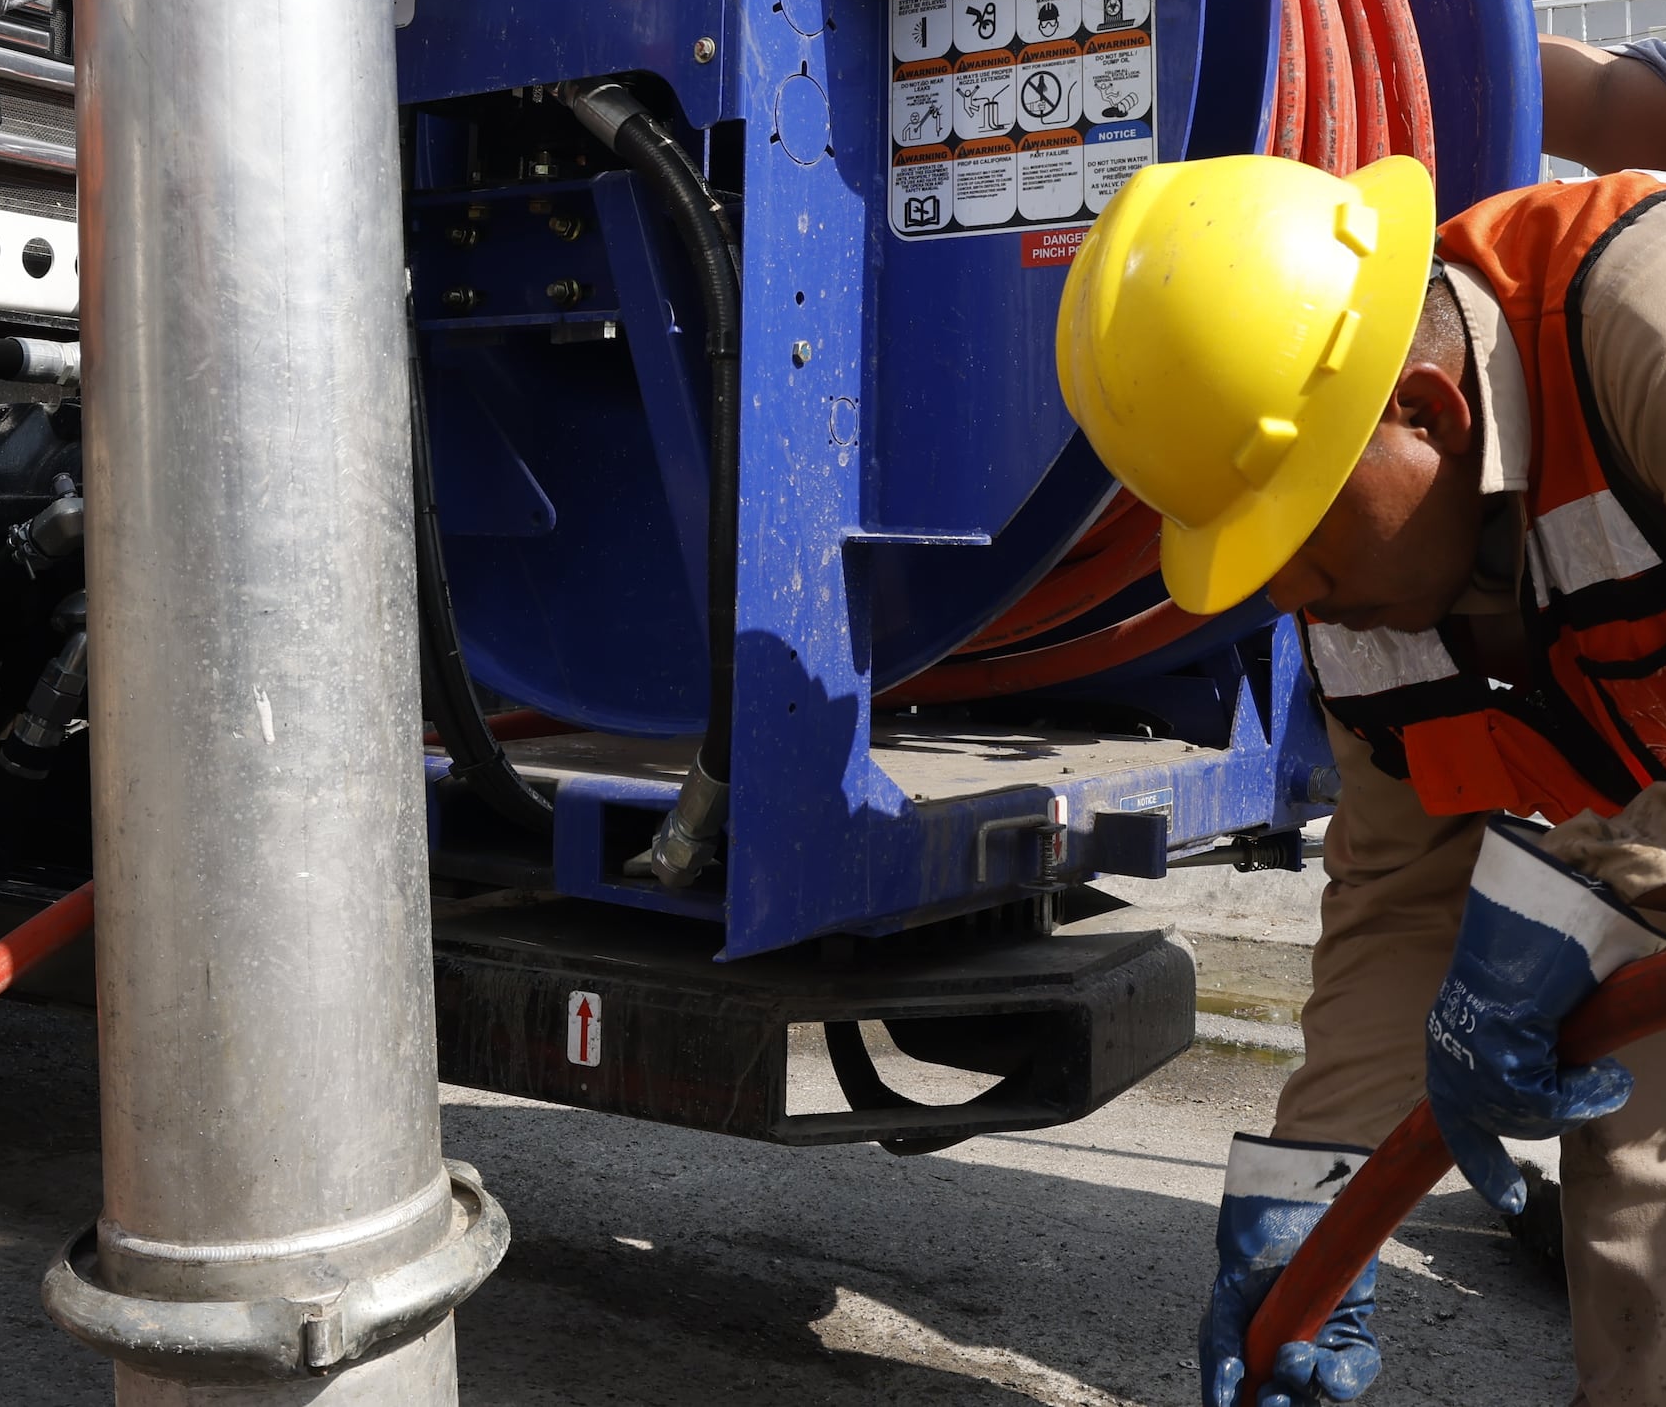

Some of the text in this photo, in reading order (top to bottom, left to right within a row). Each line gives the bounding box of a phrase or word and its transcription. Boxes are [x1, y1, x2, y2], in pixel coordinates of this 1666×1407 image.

[1098, 36, 1144, 50] WARNING
[1031, 46, 1075, 60] WARNING
[967, 56, 1010, 69] WARNING
[906, 65, 947, 78] WARNING
[1098, 128, 1136, 141] NOTICE
[1031, 135, 1076, 148] WARNING
[967, 143, 1010, 156] WARNING
[1045, 148, 1068, 156] FAILURE
[905, 150, 947, 163] WARNING
[1127, 154, 1147, 163] WATER
[1032, 246, 1064, 259] PINCH
[1137, 794, 1158, 807] NOTICE
[1459, 1006, 1476, 1033] CE
